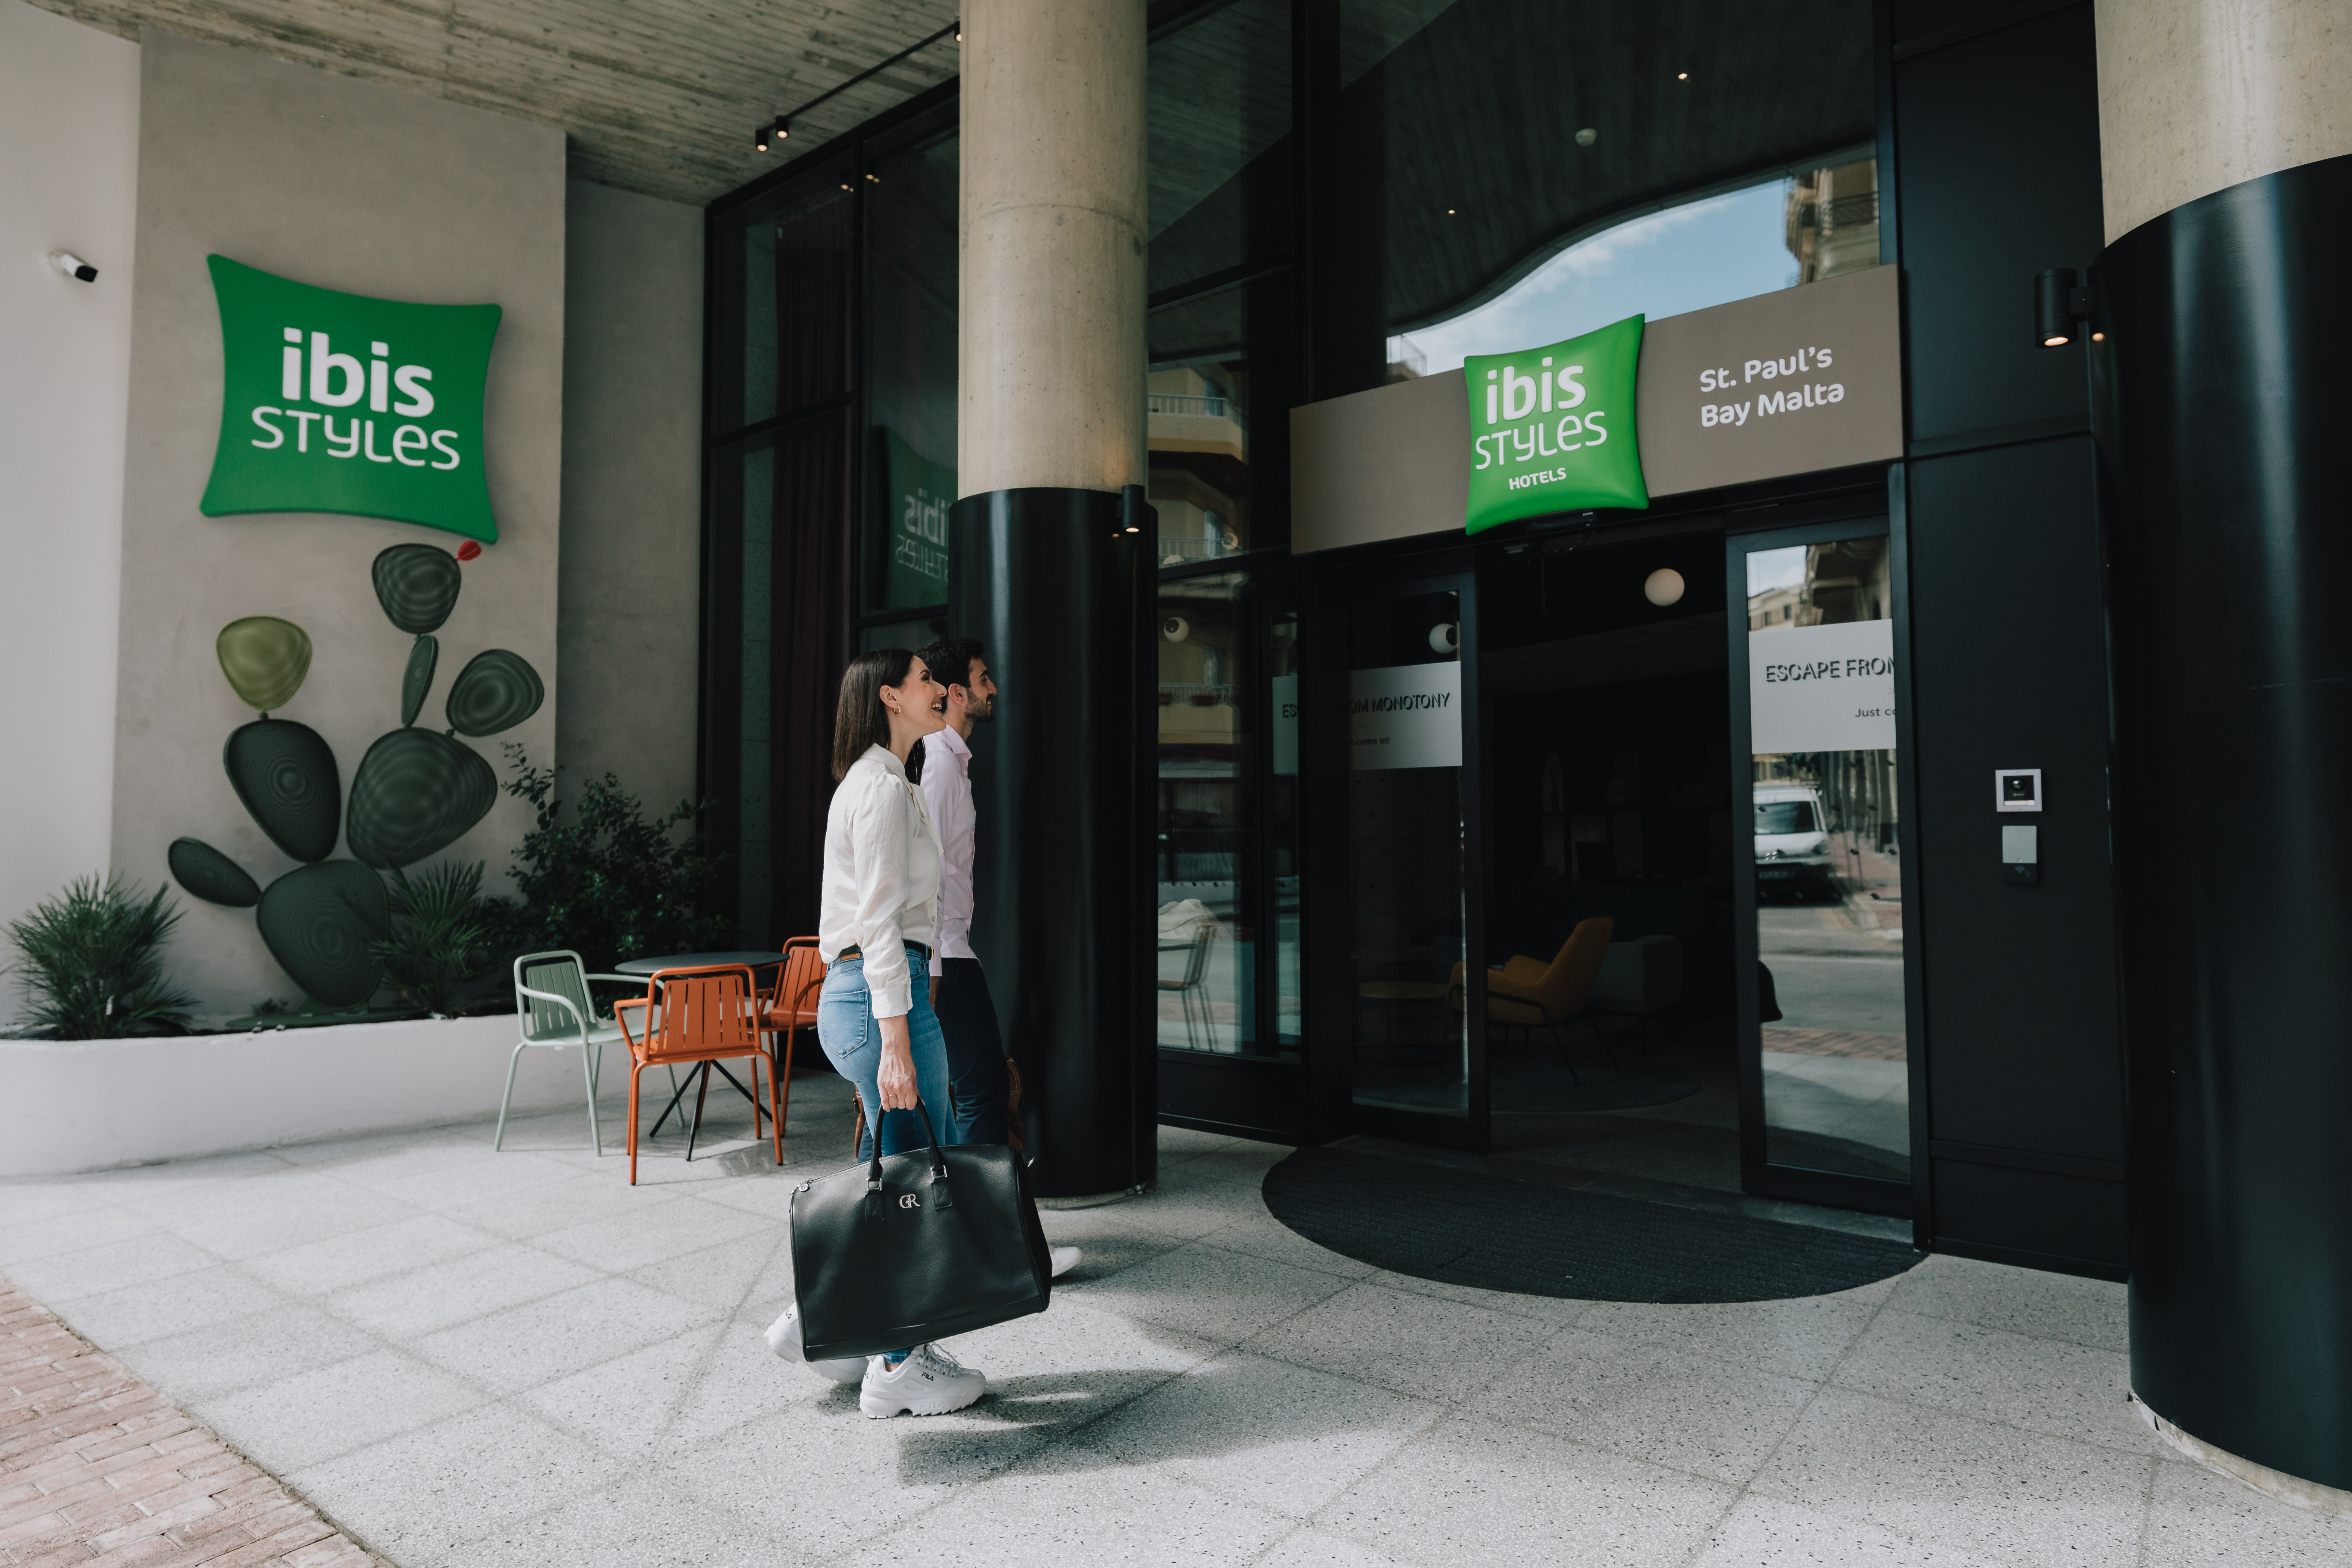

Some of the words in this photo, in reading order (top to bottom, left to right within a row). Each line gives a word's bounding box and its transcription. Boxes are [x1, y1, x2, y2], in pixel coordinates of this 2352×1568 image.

[282, 327, 435, 418] ibis
[1699, 367, 1737, 393] St.
[1744, 346, 1833, 384] Paul's
[1487, 356, 1586, 425] ibis
[1701, 401, 1751, 428] Bay
[1757, 383, 1845, 417] Malta
[1509, 467, 1567, 490] HOTELS
[1766, 659, 1841, 683] ESCAPE
[1371, 692, 1450, 713] MONOTONY
[1855, 708, 1881, 718] Just
[1379, 736, 1389, 744] in!
[921, 1372, 935, 1381] FILA
[920, 1401, 949, 1410] FILA
